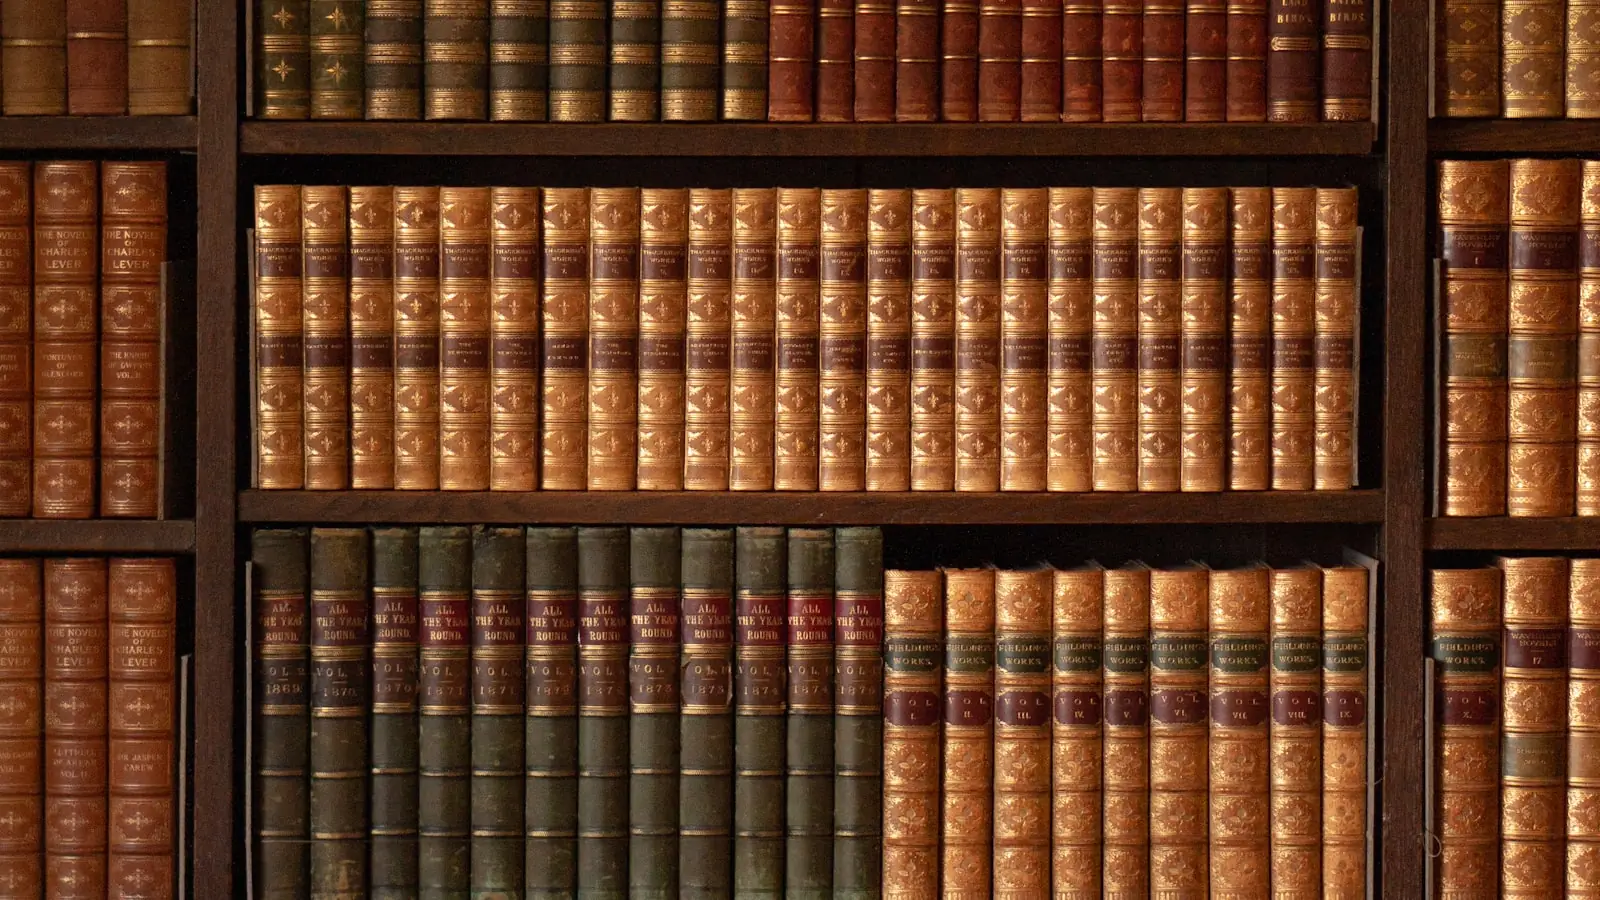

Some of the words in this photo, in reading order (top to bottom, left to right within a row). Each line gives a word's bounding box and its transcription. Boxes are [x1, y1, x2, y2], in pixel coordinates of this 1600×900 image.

[1277, 14, 1312, 23] BIRDS
[1329, 13, 1364, 22] BIRDS
[106, 231, 121, 239] THE
[40, 248, 88, 256] CHARLES
[107, 248, 156, 257] CHARLES
[45, 260, 82, 269] LEVER
[112, 260, 150, 269] LEVER
[272, 603, 291, 613] ALL
[328, 604, 349, 614] ALL
[383, 602, 404, 612] ALL
[435, 605, 455, 615] ALL
[488, 604, 509, 614] ALL
[542, 606, 563, 616] ALL
[594, 605, 614, 615] ALL
[646, 603, 666, 613] ALL
[698, 604, 718, 613] ALL
[751, 604, 771, 614] ALL
[801, 604, 821, 614] ALL
[849, 605, 869, 615] ALL
[316, 616, 336, 627] THE
[423, 617, 442, 627] THE
[475, 616, 494, 626] THE
[529, 617, 549, 627] THE
[581, 617, 600, 627] THE
[631, 615, 650, 625] THE
[685, 615, 704, 625] THE
[737, 616, 756, 626] THE
[787, 616, 806, 626] THE
[836, 617, 855, 627] THE
[132, 629, 168, 638] NOVELS
[116, 645, 163, 655] CHARLES
[0, 658, 31, 666] EVER
[56, 658, 94, 667] LEVER
[122, 657, 157, 667] LEVER
[1533, 656, 1543, 665] 17
